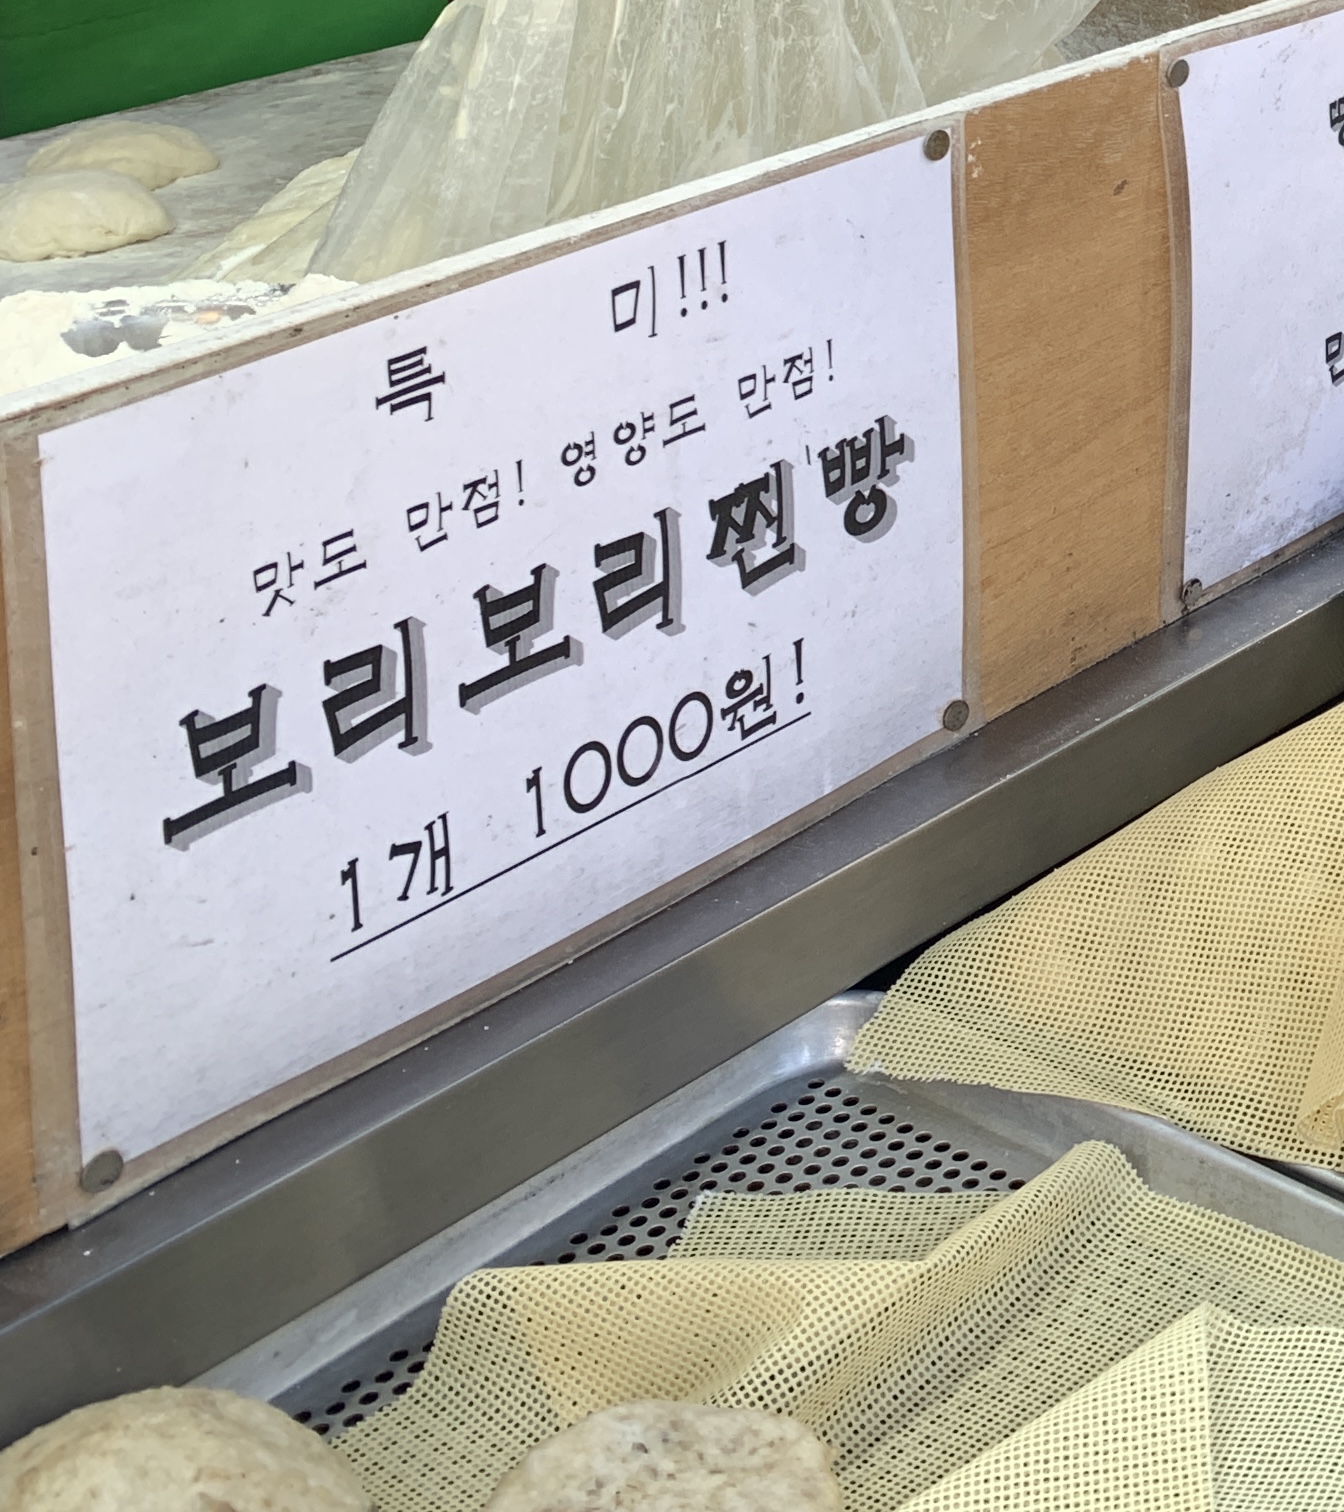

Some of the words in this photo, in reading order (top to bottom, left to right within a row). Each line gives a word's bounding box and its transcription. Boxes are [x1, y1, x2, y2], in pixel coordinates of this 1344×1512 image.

[375, 345, 446, 421] 특
[610, 239, 730, 338] 미!!!
[252, 527, 368, 618] 맛도
[405, 458, 527, 554] 만점!
[560, 394, 706, 486] 영양도
[736, 337, 836, 420] 만점!
[340, 812, 453, 933] 1개
[525, 637, 805, 838] 1000원!
